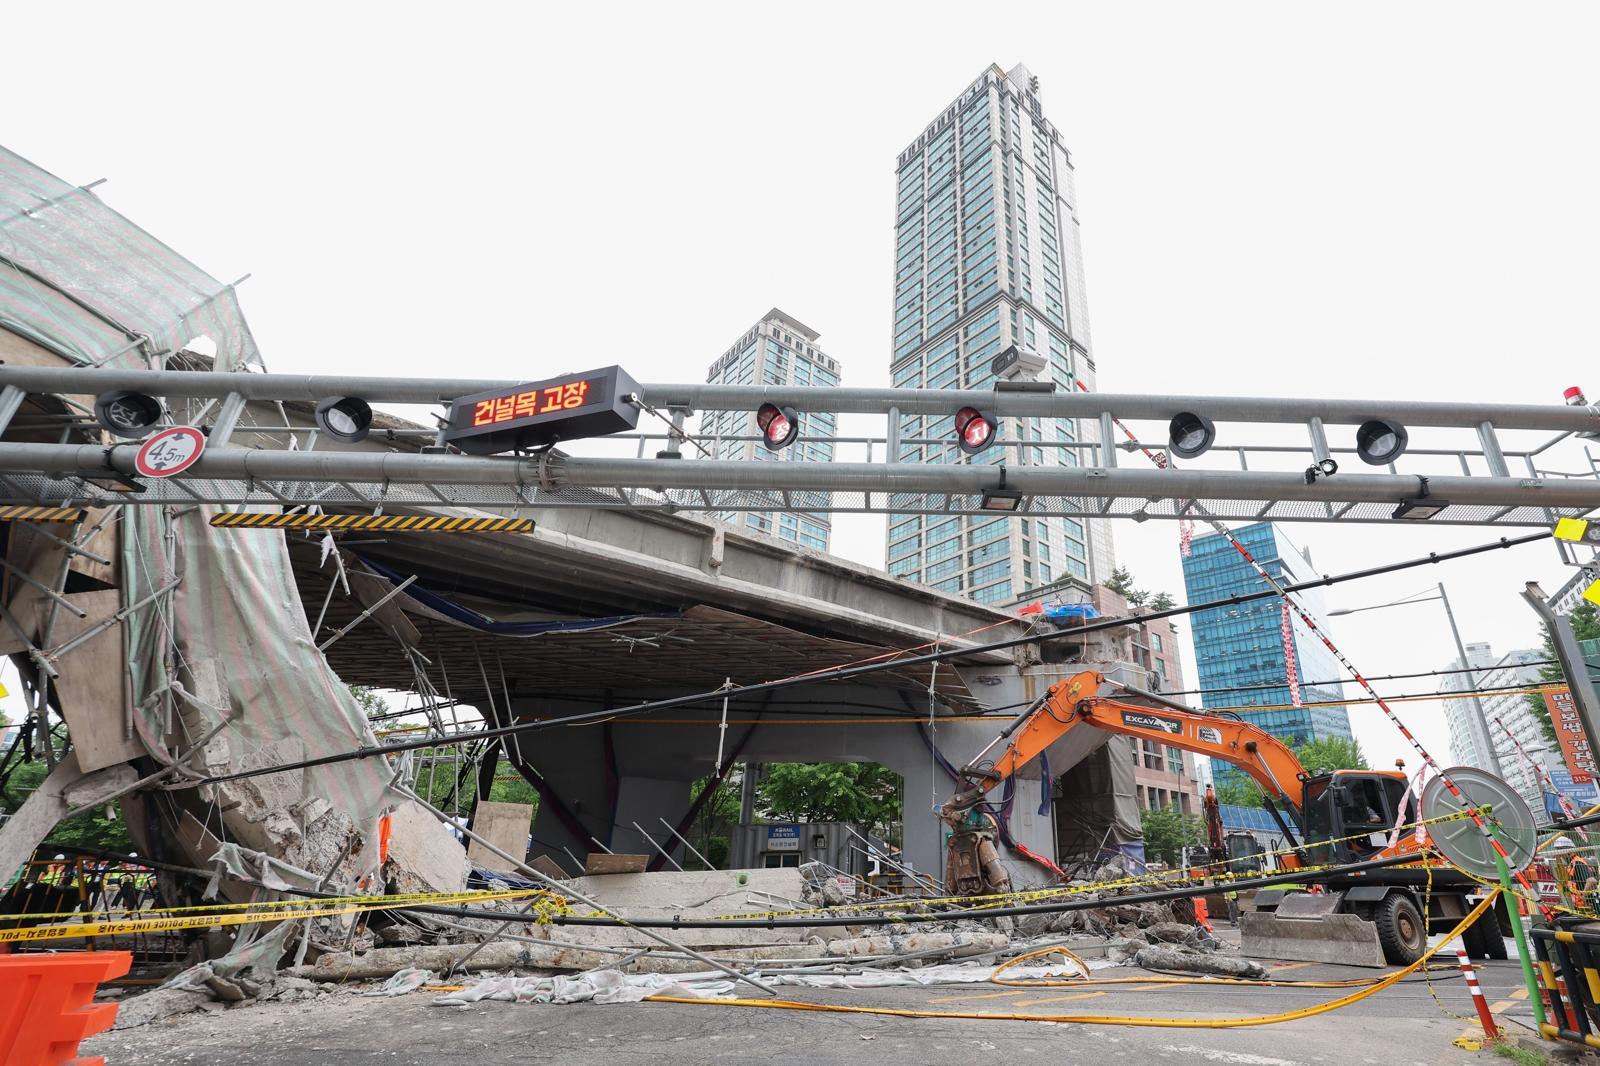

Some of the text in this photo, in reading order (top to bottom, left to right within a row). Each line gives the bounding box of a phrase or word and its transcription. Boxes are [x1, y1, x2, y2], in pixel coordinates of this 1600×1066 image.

[474, 381, 587, 425] 건널목 고장
[149, 440, 185, 462] 4.5m
[1125, 714, 1178, 729] EXCAVAOR
